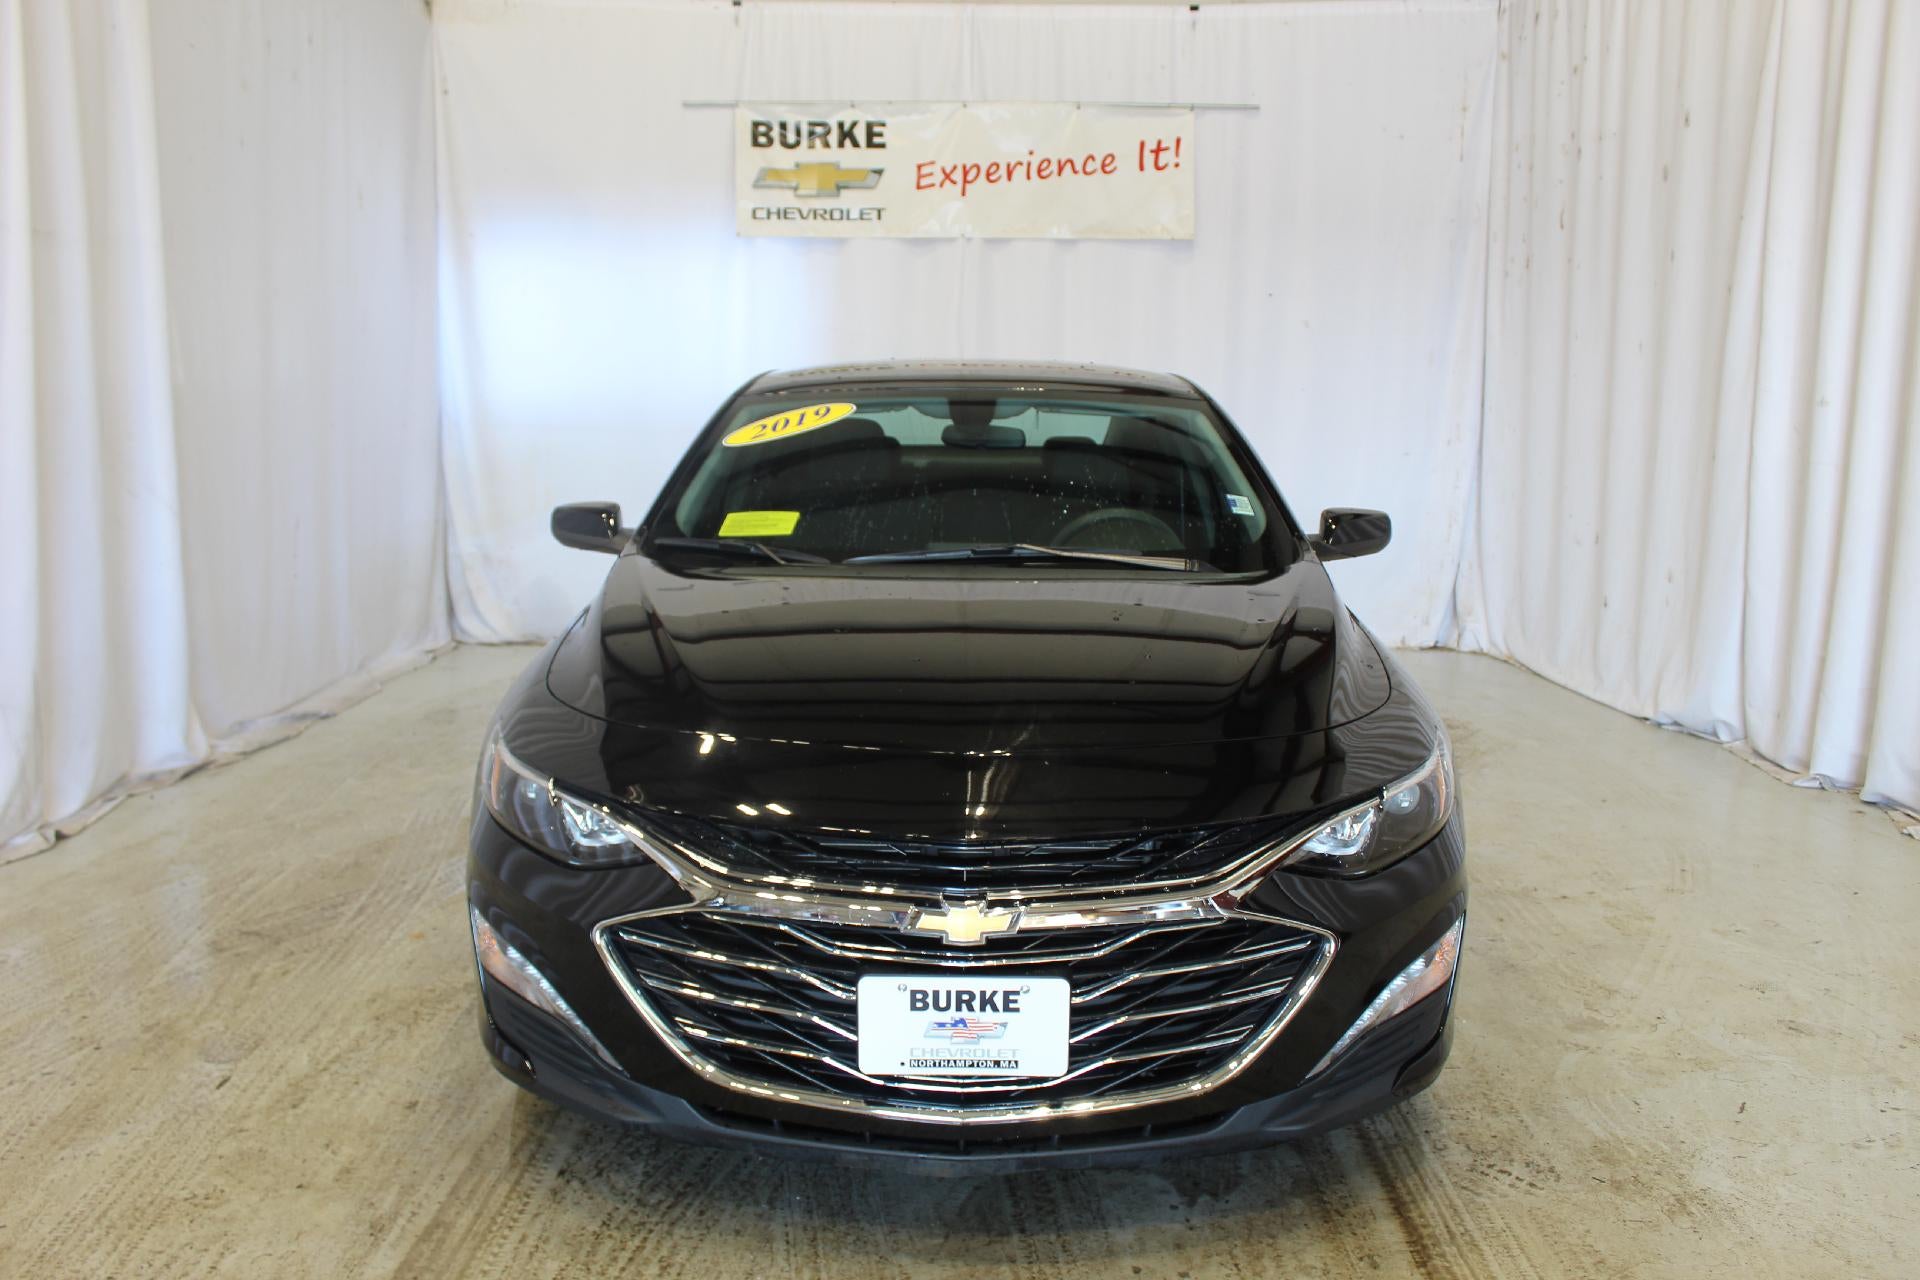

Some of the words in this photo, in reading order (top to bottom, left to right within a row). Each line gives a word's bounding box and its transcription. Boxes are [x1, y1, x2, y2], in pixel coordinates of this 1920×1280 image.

[750, 119, 887, 149] BURKE
[914, 150, 1118, 196] Experience
[1138, 137, 1182, 172] It!
[751, 206, 886, 221] CHEVROLET
[751, 405, 831, 440] 2019
[909, 989, 1021, 1013] BURKE
[909, 1047, 1018, 1059] CHEVROLET
